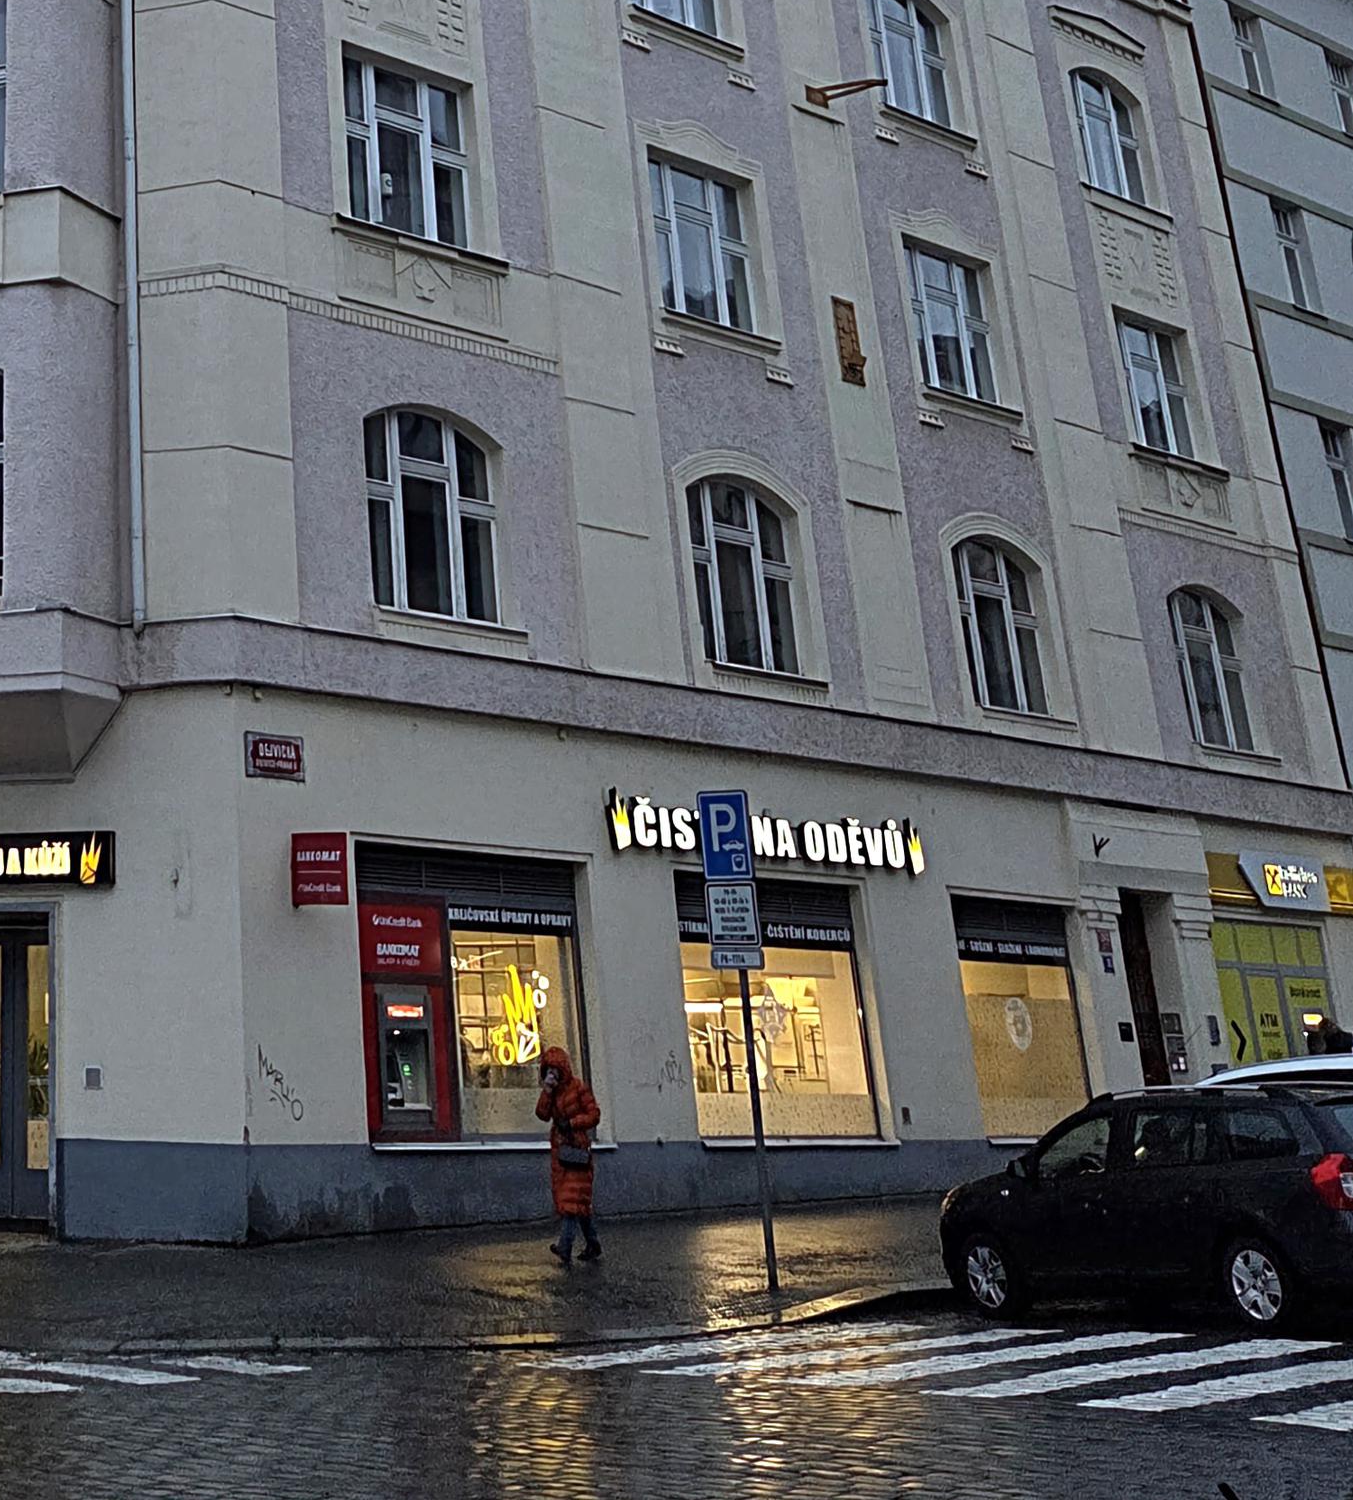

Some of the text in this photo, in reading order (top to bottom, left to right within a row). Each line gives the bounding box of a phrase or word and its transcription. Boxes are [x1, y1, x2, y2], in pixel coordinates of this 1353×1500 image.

[632, 795, 906, 869] ČISNA ODĚVŮ
[709, 803, 737, 852] P
[5, 847, 22, 876] A
[23, 840, 71, 876] KŮŽÍ
[296, 850, 341, 863] BANKOMAT
[534, 913, 540, 925] A
[1260, 1013, 1279, 1028] ATM
